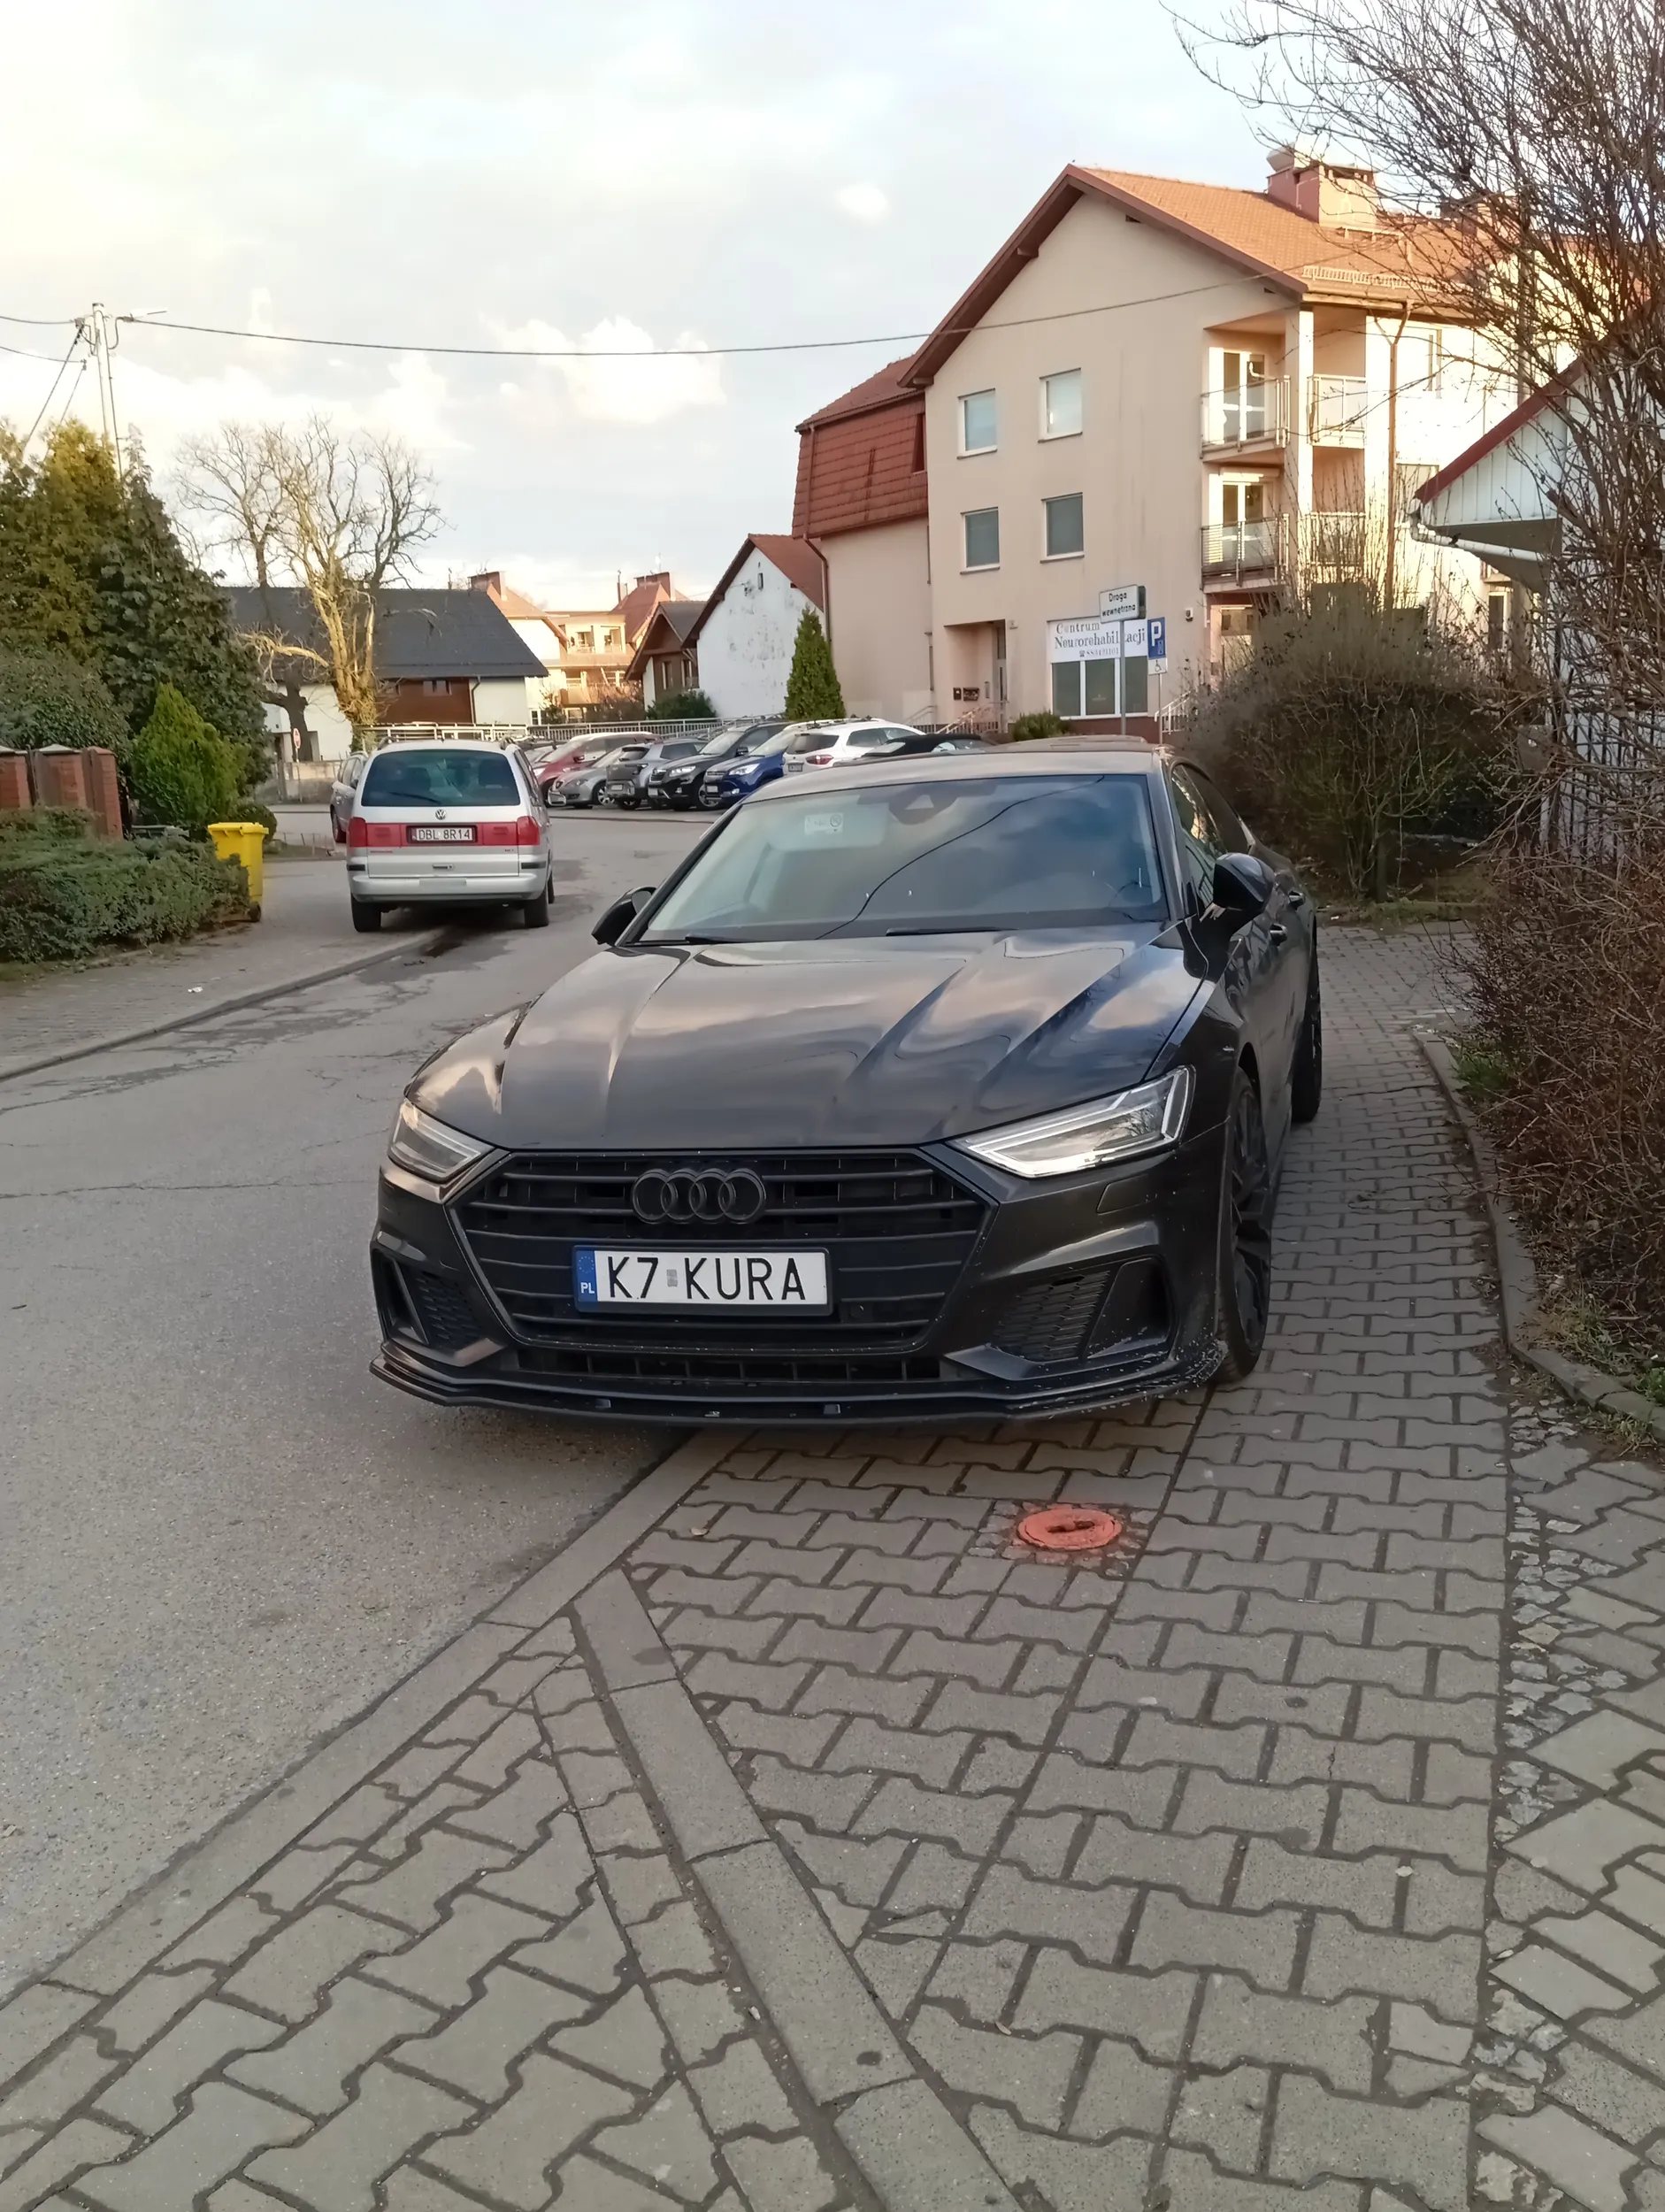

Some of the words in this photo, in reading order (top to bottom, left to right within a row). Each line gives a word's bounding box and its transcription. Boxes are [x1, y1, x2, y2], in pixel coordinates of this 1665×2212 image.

[1109, 592, 1127, 603] Droga
[1101, 604, 1136, 617] wewnętrzna
[1054, 628, 1146, 649] Neurorehabilacji
[1150, 621, 1162, 647] P
[418, 829, 440, 840] DBL
[443, 829, 471, 840] 8R14
[607, 1256, 659, 1299] K7
[684, 1256, 806, 1301] KURA
[580, 1282, 595, 1294] PL
